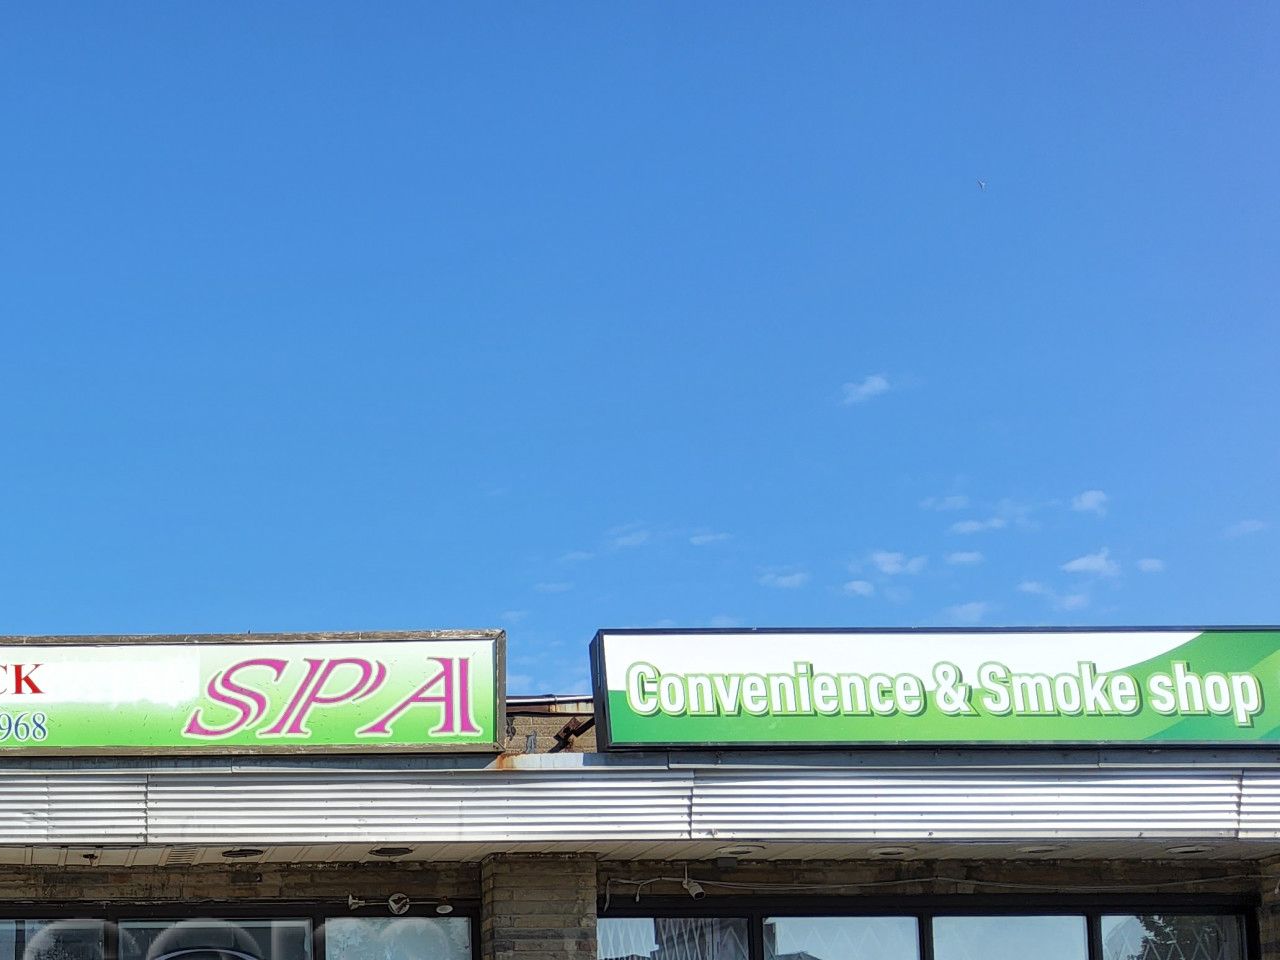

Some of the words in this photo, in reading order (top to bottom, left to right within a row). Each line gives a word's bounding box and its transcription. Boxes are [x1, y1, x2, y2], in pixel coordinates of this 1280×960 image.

[185, 657, 480, 736] SPA
[625, 661, 924, 717] Convenience
[934, 661, 978, 717] &
[980, 660, 1141, 716] Smoke
[1150, 660, 1263, 727] shop
